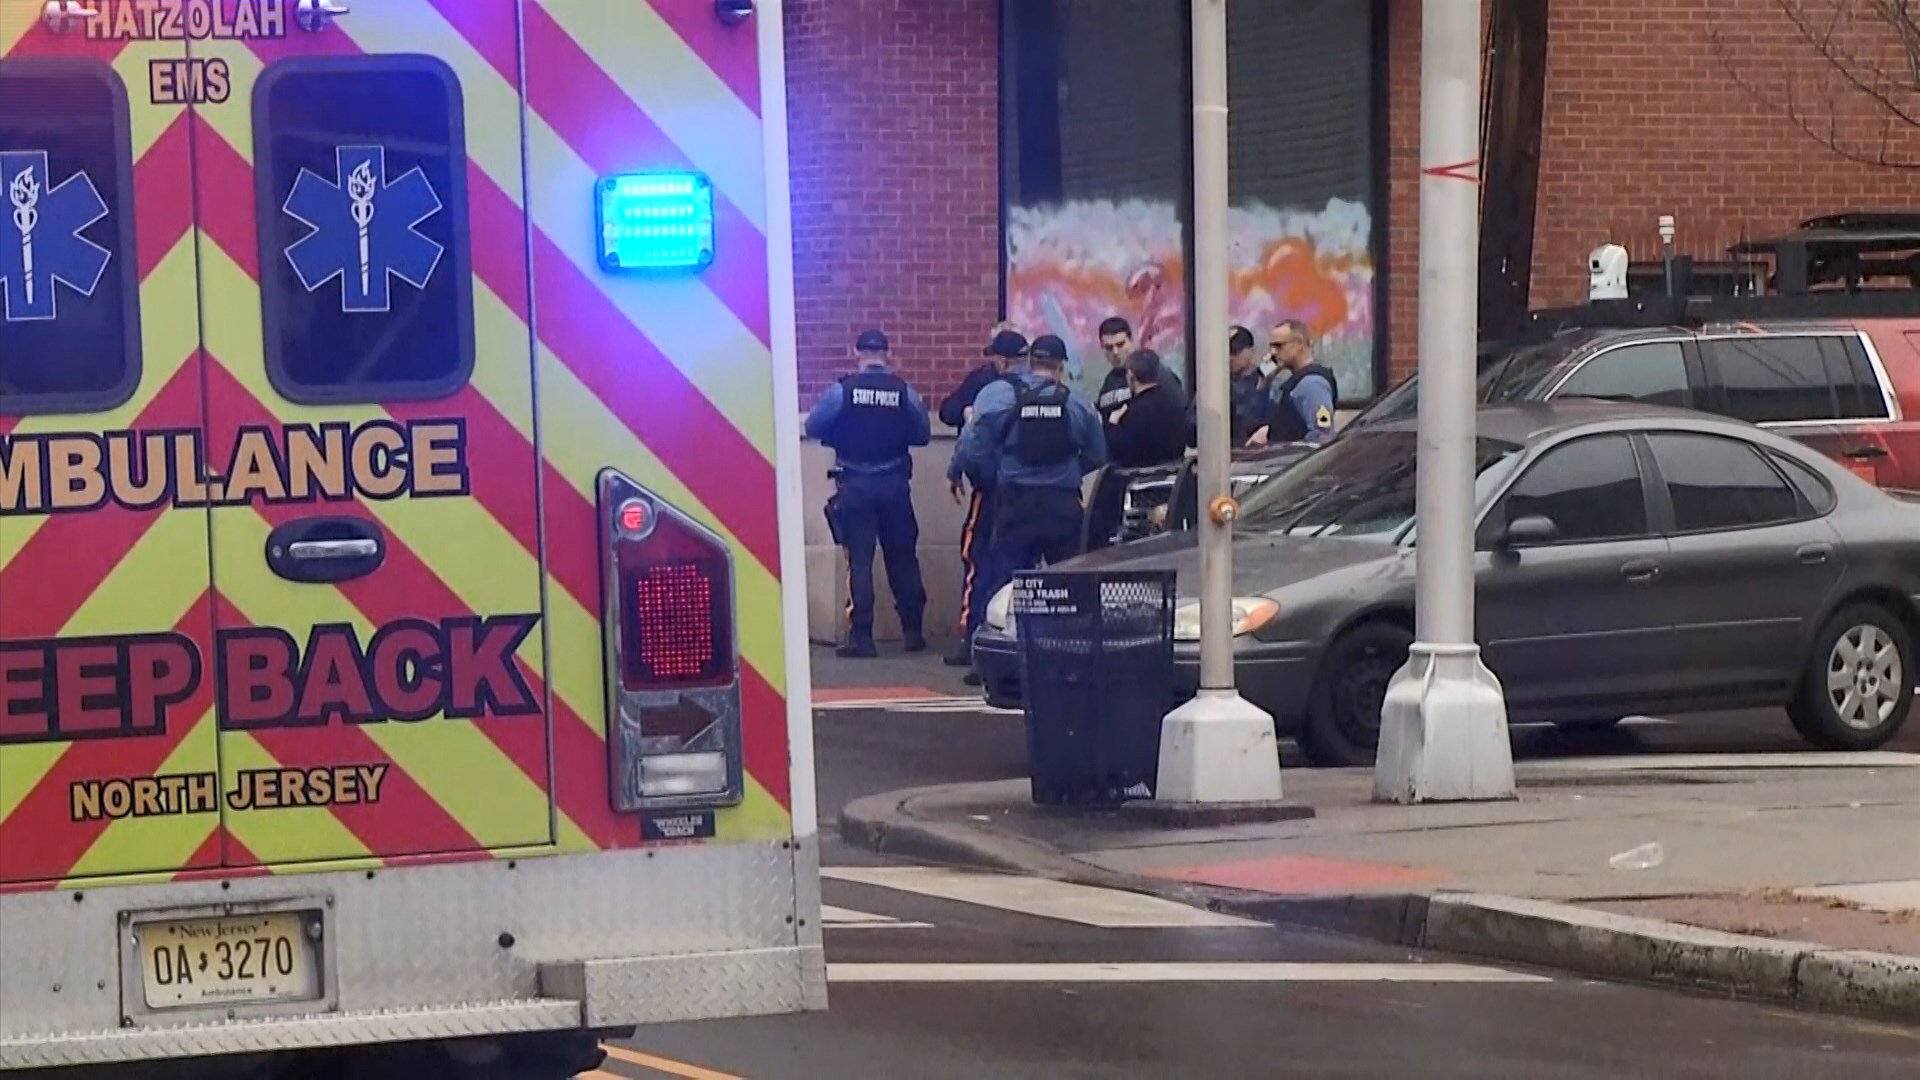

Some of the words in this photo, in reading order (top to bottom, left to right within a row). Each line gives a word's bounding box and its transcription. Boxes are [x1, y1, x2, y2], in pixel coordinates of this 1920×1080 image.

[85, 0, 286, 40] HATZOLAH
[149, 58, 231, 104] EMS
[852, 388, 875, 405] STATE
[875, 390, 900, 407] POLICE
[1025, 579, 1044, 589] CITY
[1036, 589, 1069, 599] TRASH
[0, 631, 203, 744] EEP
[217, 613, 542, 731] BACK
[70, 772, 218, 822] NORTH
[227, 763, 390, 810] JERSEY
[180, 923, 213, 939] New
[216, 921, 262, 939] Jersey
[215, 936, 294, 981] 3270
